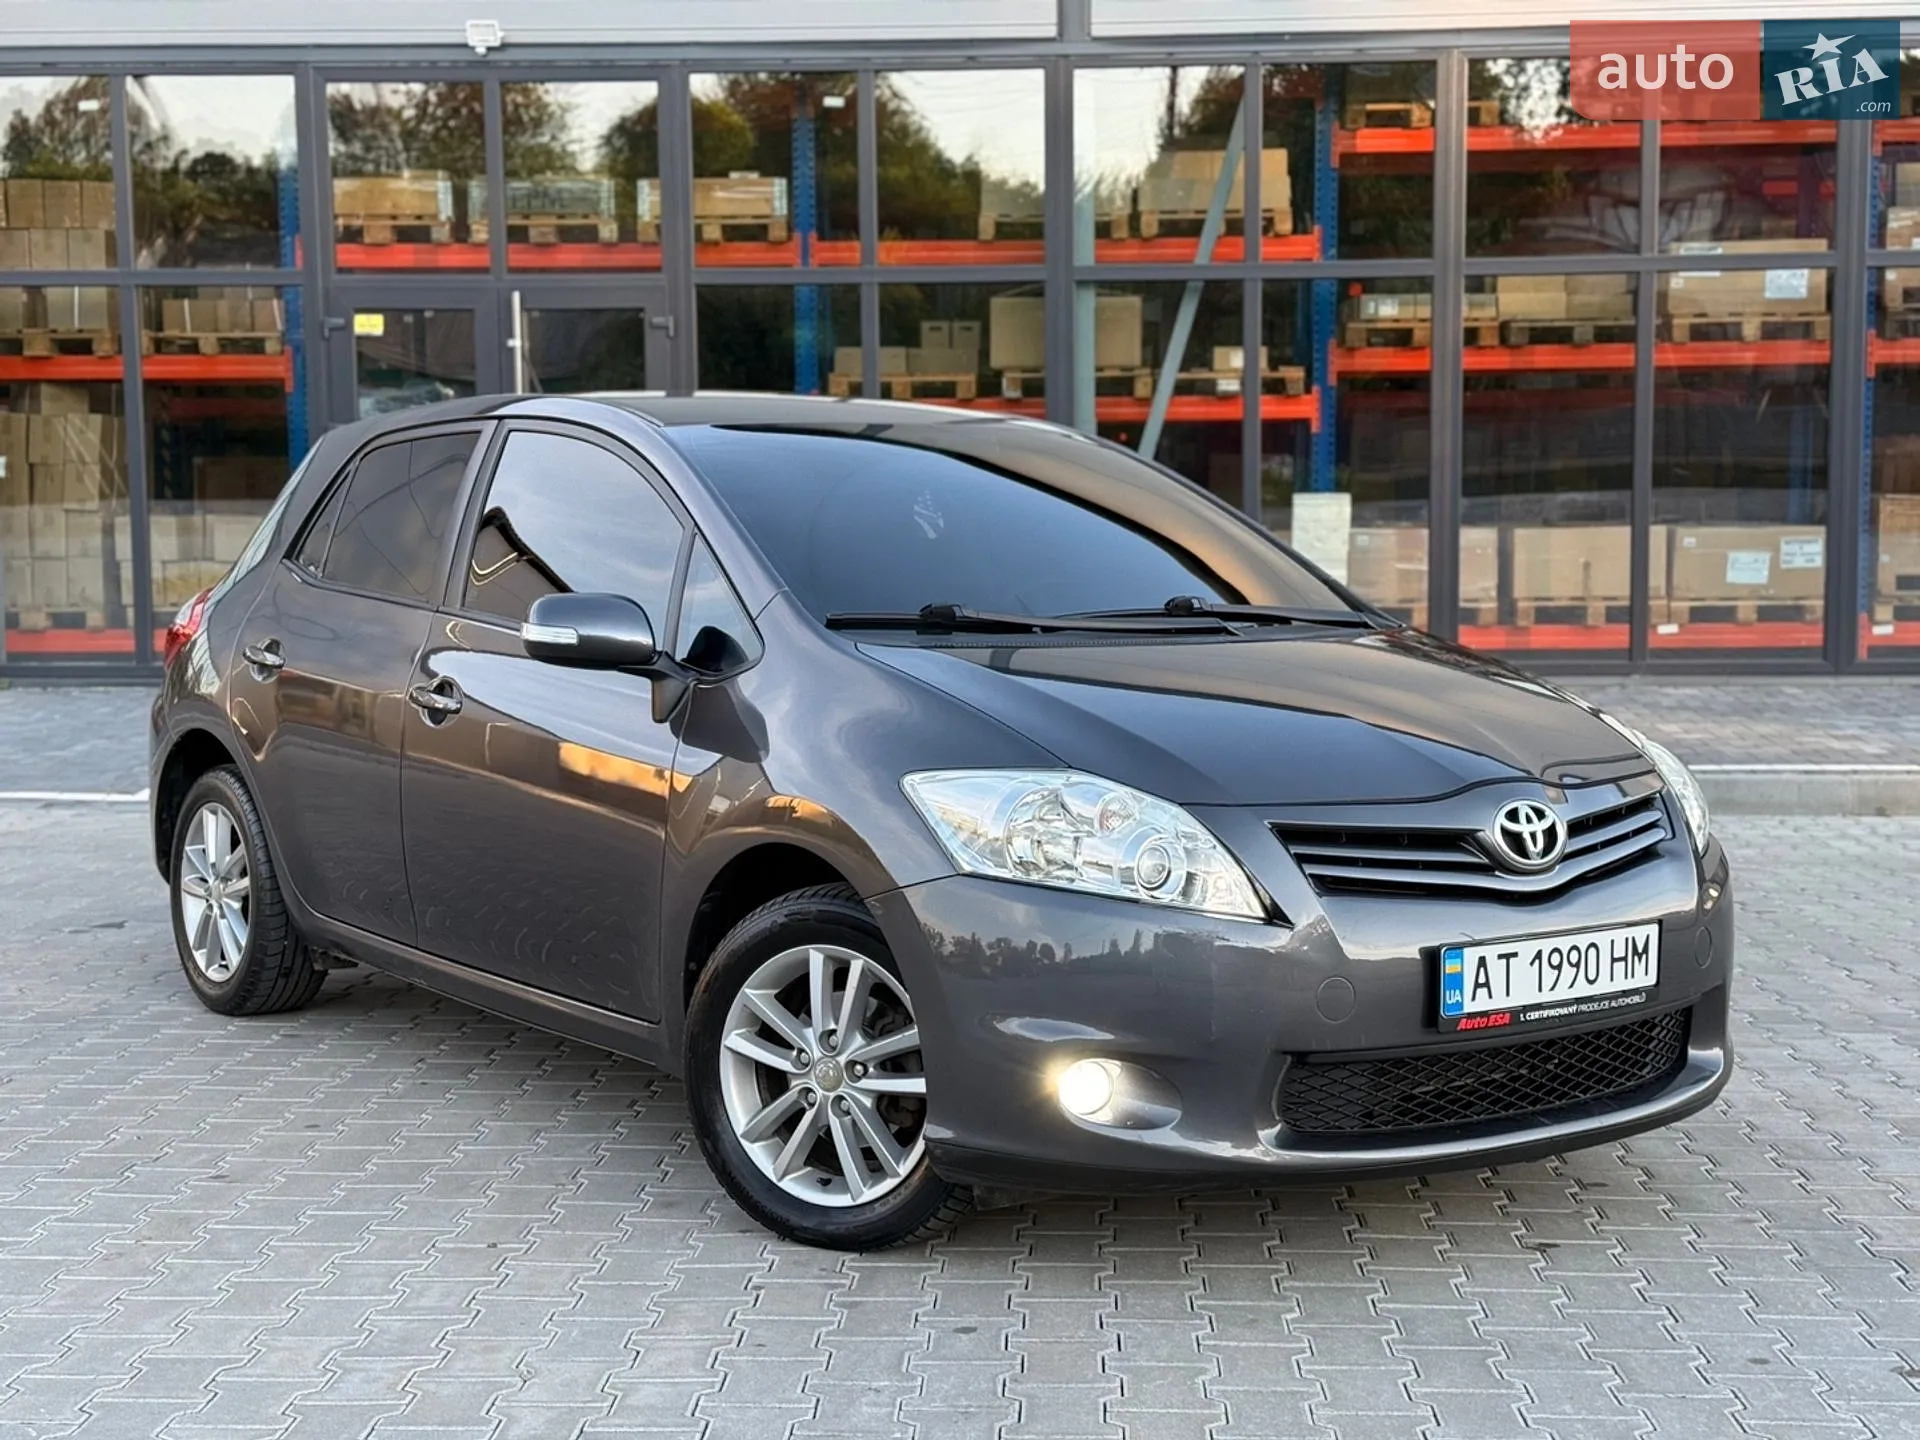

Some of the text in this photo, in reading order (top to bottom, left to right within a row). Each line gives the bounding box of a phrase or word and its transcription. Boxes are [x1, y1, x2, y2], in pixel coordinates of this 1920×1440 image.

[1471, 933, 1650, 1002] AT 1990 HM
[1446, 989, 1462, 1004] UA
[1457, 1012, 1511, 1030] Auto ESA
